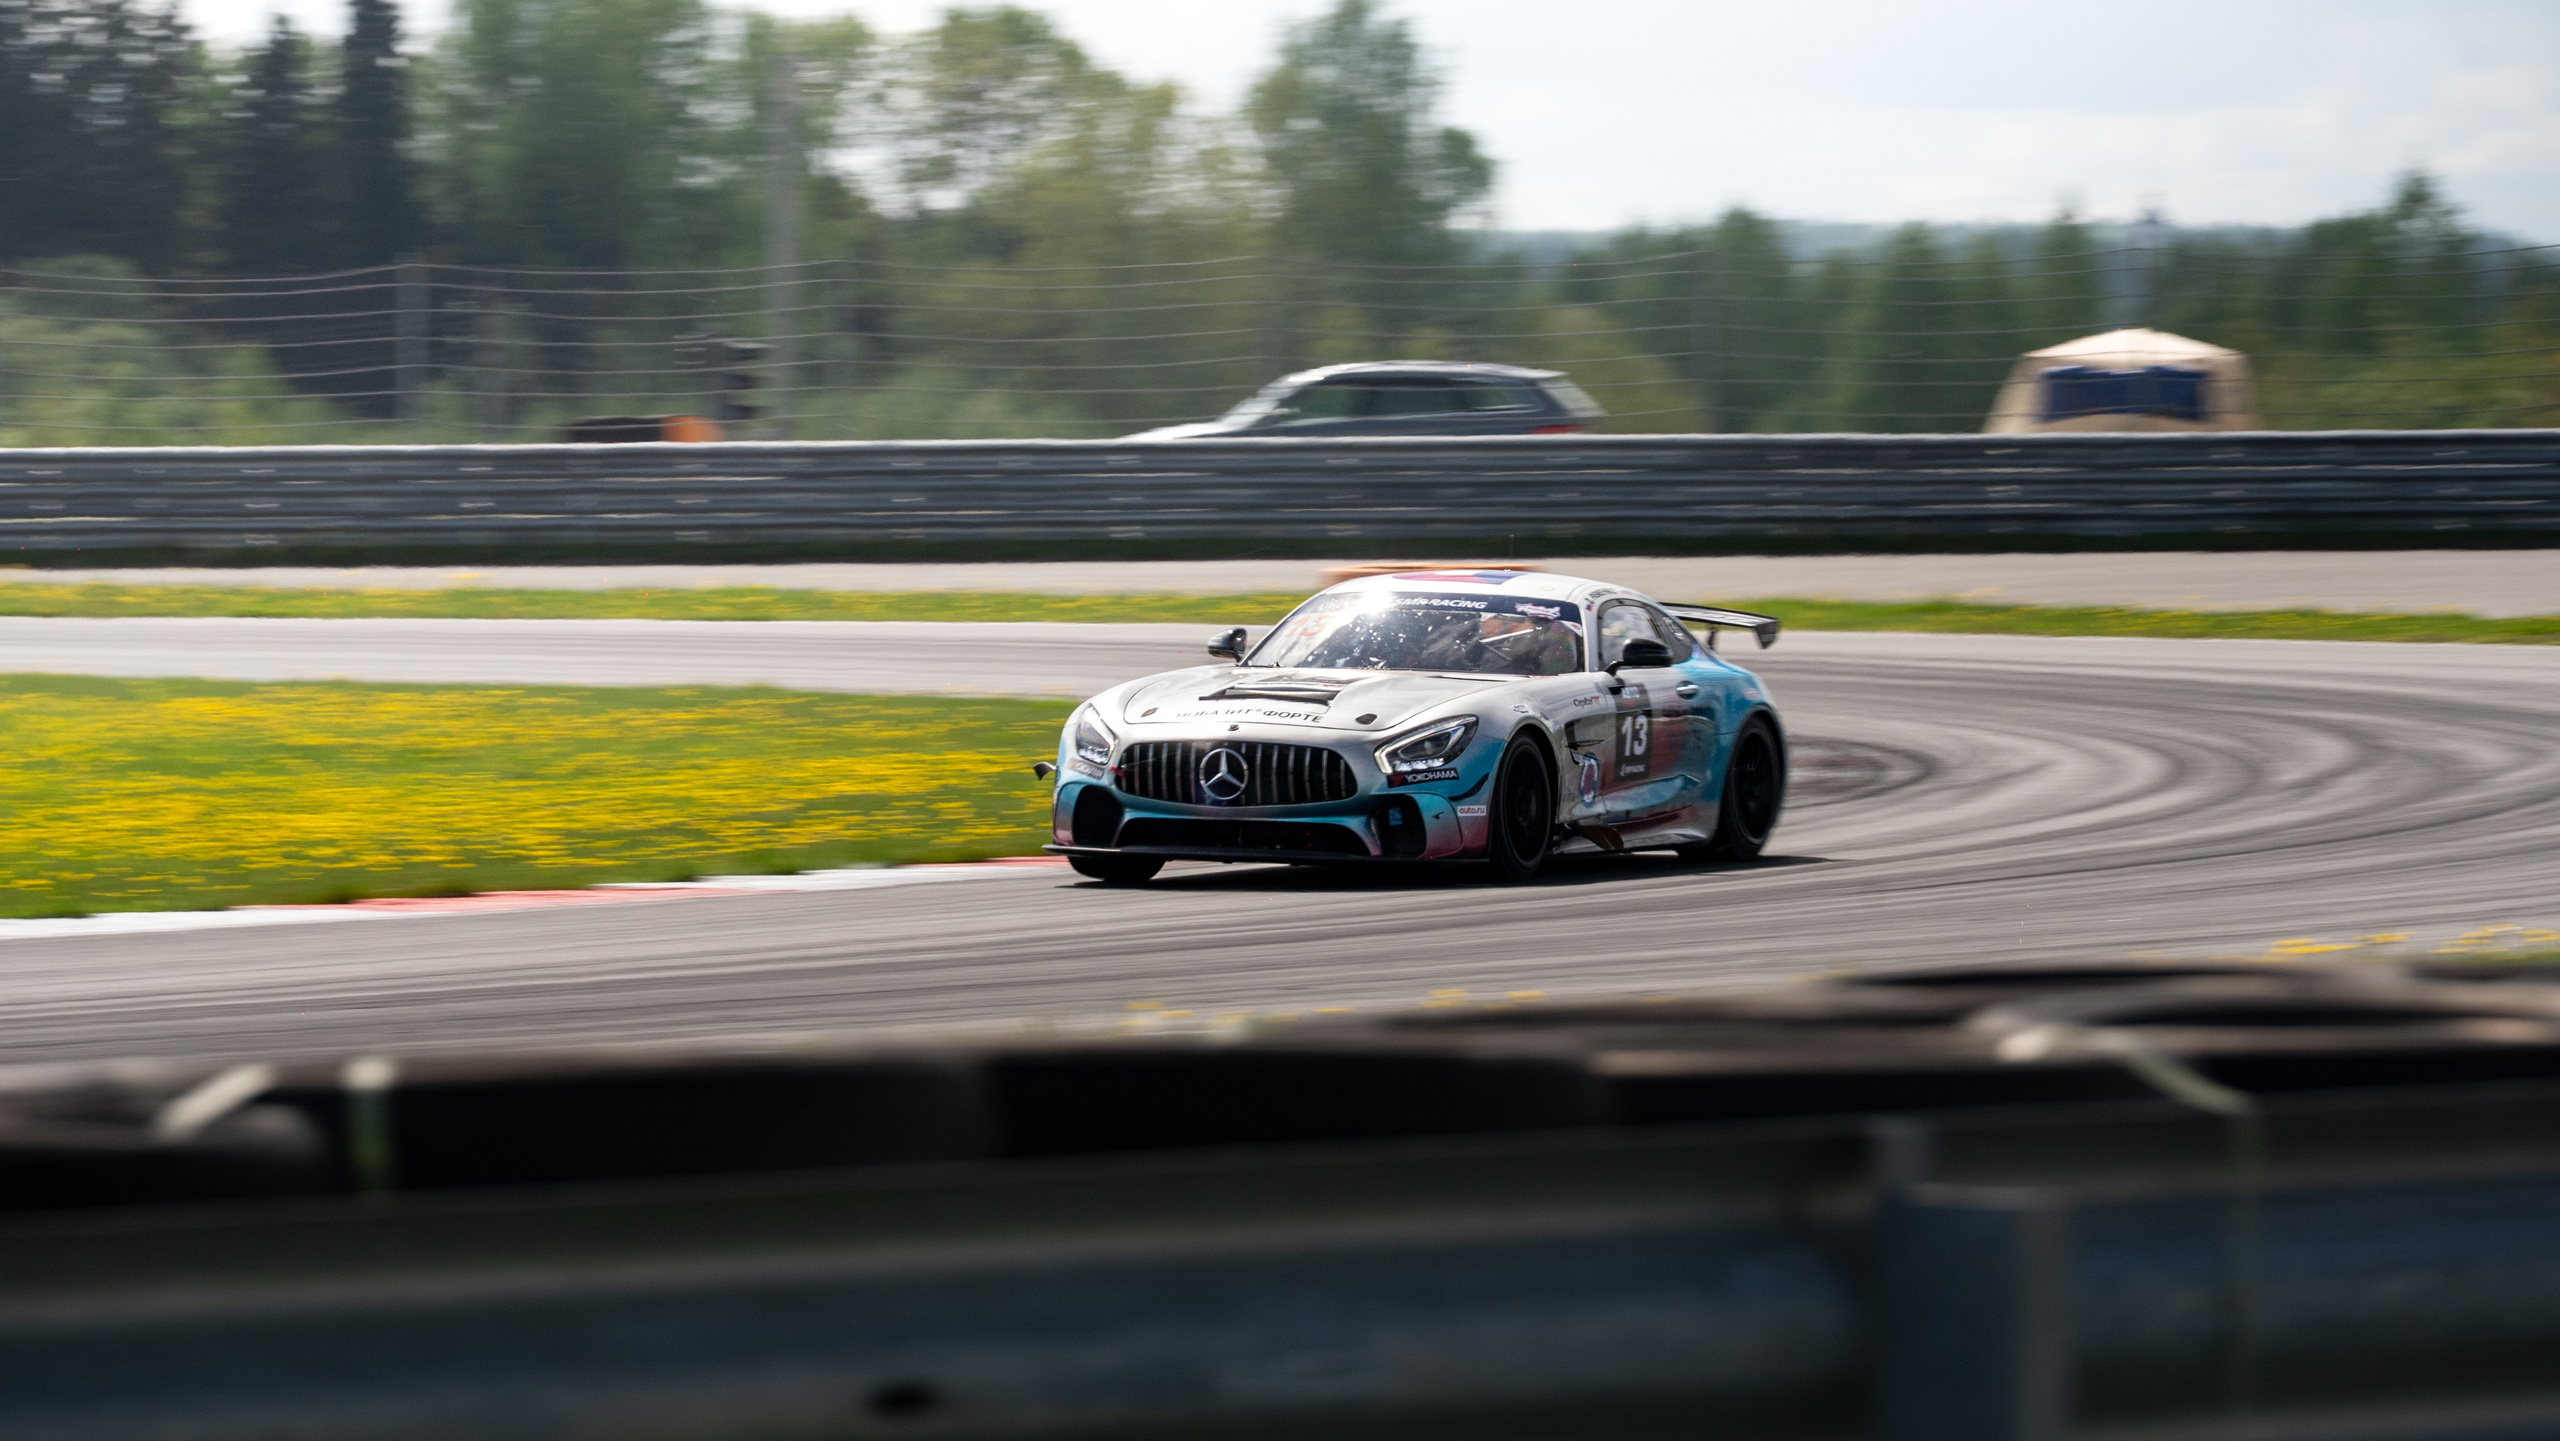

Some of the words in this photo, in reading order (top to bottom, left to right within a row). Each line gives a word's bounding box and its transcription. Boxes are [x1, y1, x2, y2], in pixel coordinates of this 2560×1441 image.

[1428, 598, 1488, 609] RACING
[1284, 614, 1336, 638] 13
[1263, 709, 1325, 723] ФОРТЕ
[1621, 714, 1648, 757] 13
[1405, 769, 1458, 783] YOKOHAMA
[1459, 807, 1485, 815] auto.ru
